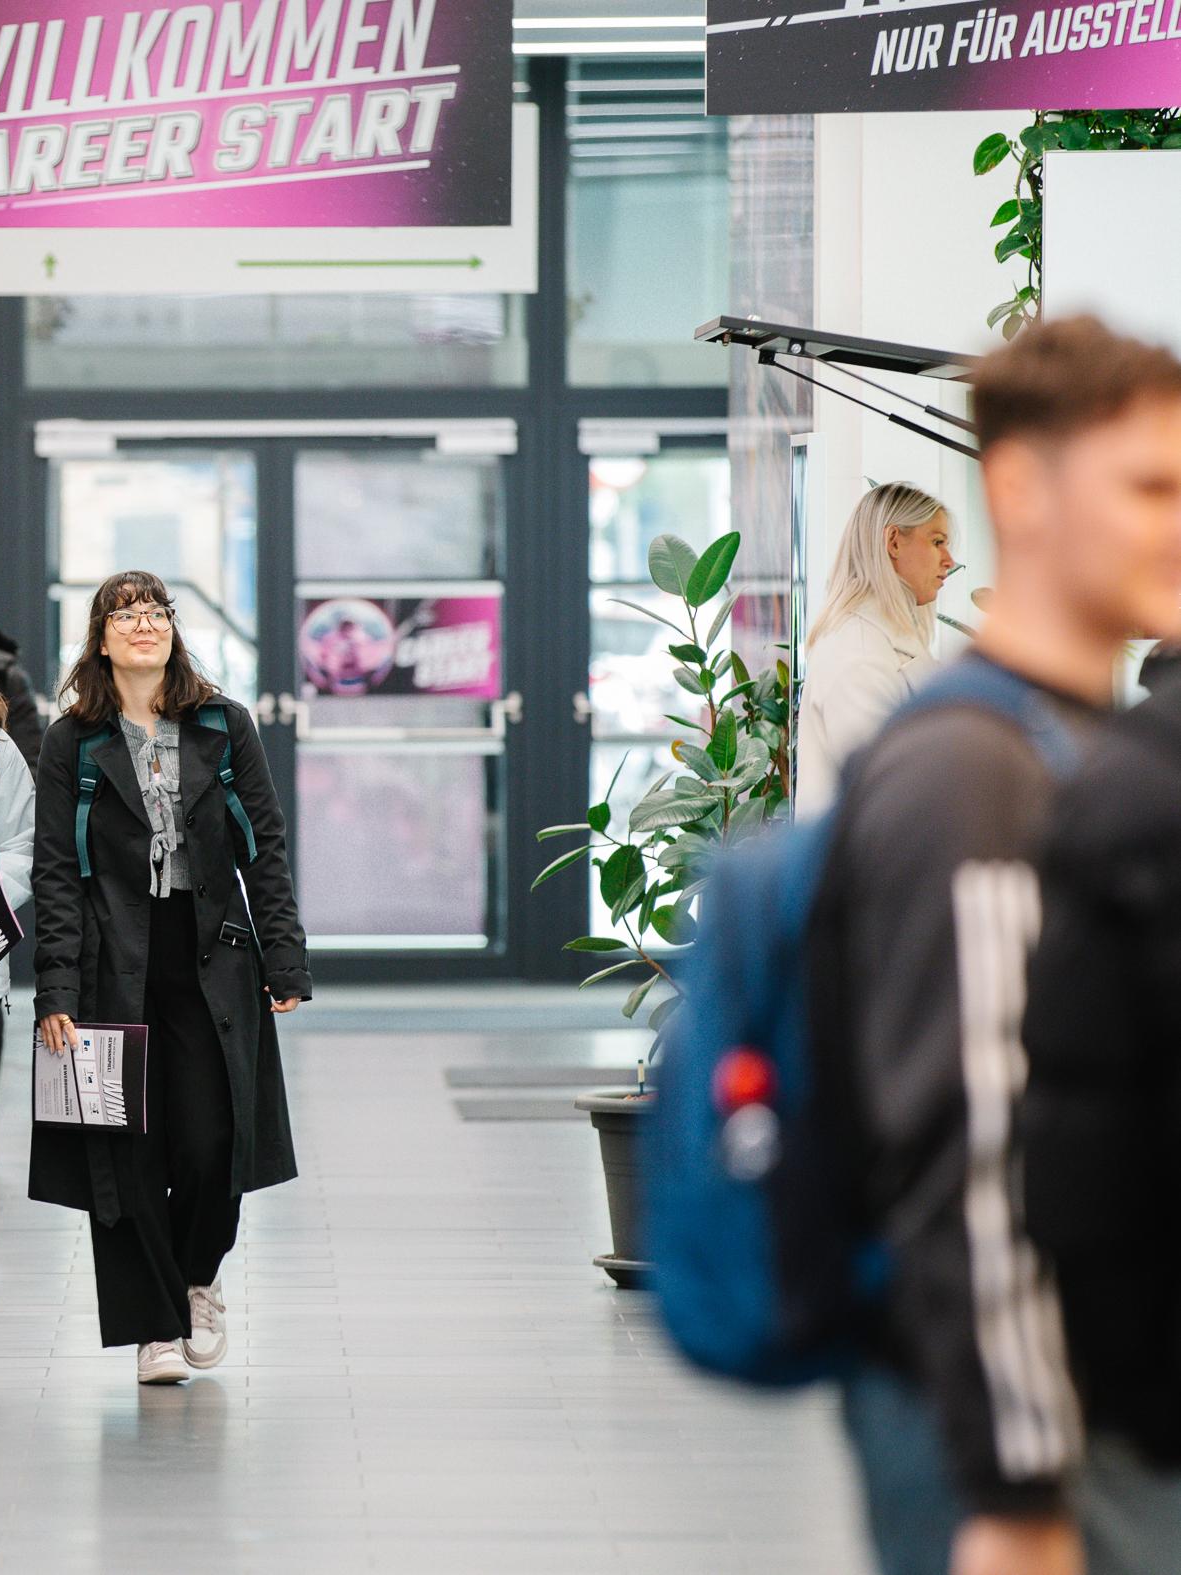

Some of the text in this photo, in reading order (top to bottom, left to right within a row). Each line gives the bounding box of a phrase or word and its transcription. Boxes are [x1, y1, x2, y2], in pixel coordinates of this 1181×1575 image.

[870, 23, 945, 76] NUR
[948, 7, 1018, 66] FÜR
[214, 82, 458, 171] START
[102, 1079, 128, 1126] WIN!
